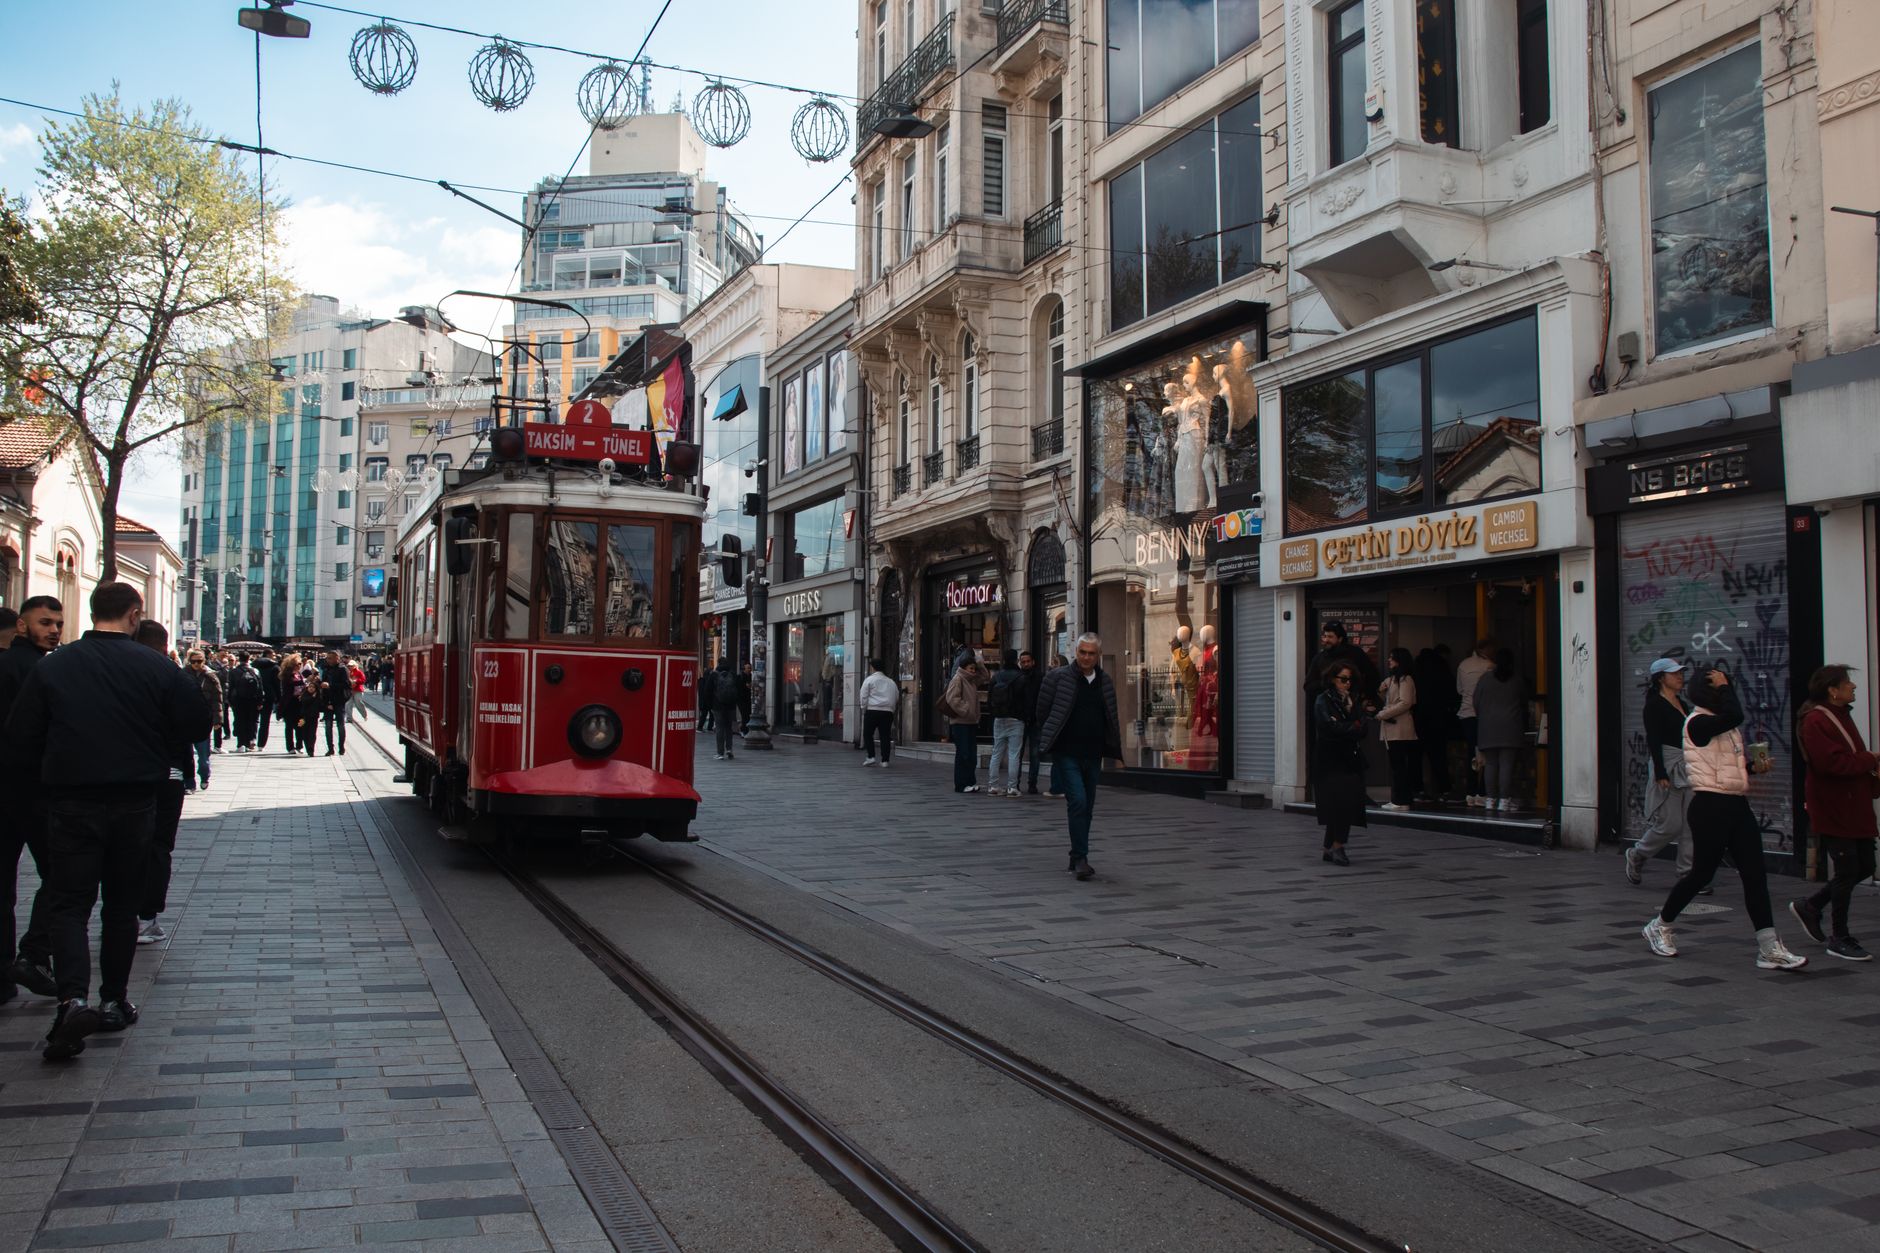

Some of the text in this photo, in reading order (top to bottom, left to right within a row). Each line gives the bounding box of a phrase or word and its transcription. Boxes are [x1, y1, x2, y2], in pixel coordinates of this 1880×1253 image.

[583, 403, 593, 424] 2
[527, 429, 576, 451] TAKSİM
[602, 433, 643, 456] TÜNEL
[1631, 455, 1745, 494] NS BAGS
[1212, 508, 1262, 543] TOYS
[1492, 508, 1525, 527] CAMBIO
[1796, 519, 1805, 529] 33
[1135, 521, 1211, 567] BENNY
[1321, 511, 1477, 570] ÇETİN DÖVİZ
[1489, 528, 1529, 547] WECHSEL
[1285, 544, 1310, 559] CHANGE
[1281, 560, 1313, 575] EXCHANGE
[714, 586, 731, 601] CHANGE
[783, 589, 821, 616] GUESS
[946, 581, 990, 608] flormar
[483, 660, 499, 678] 223
[682, 670, 693, 688] 223
[501, 703, 522, 713] YASAK
